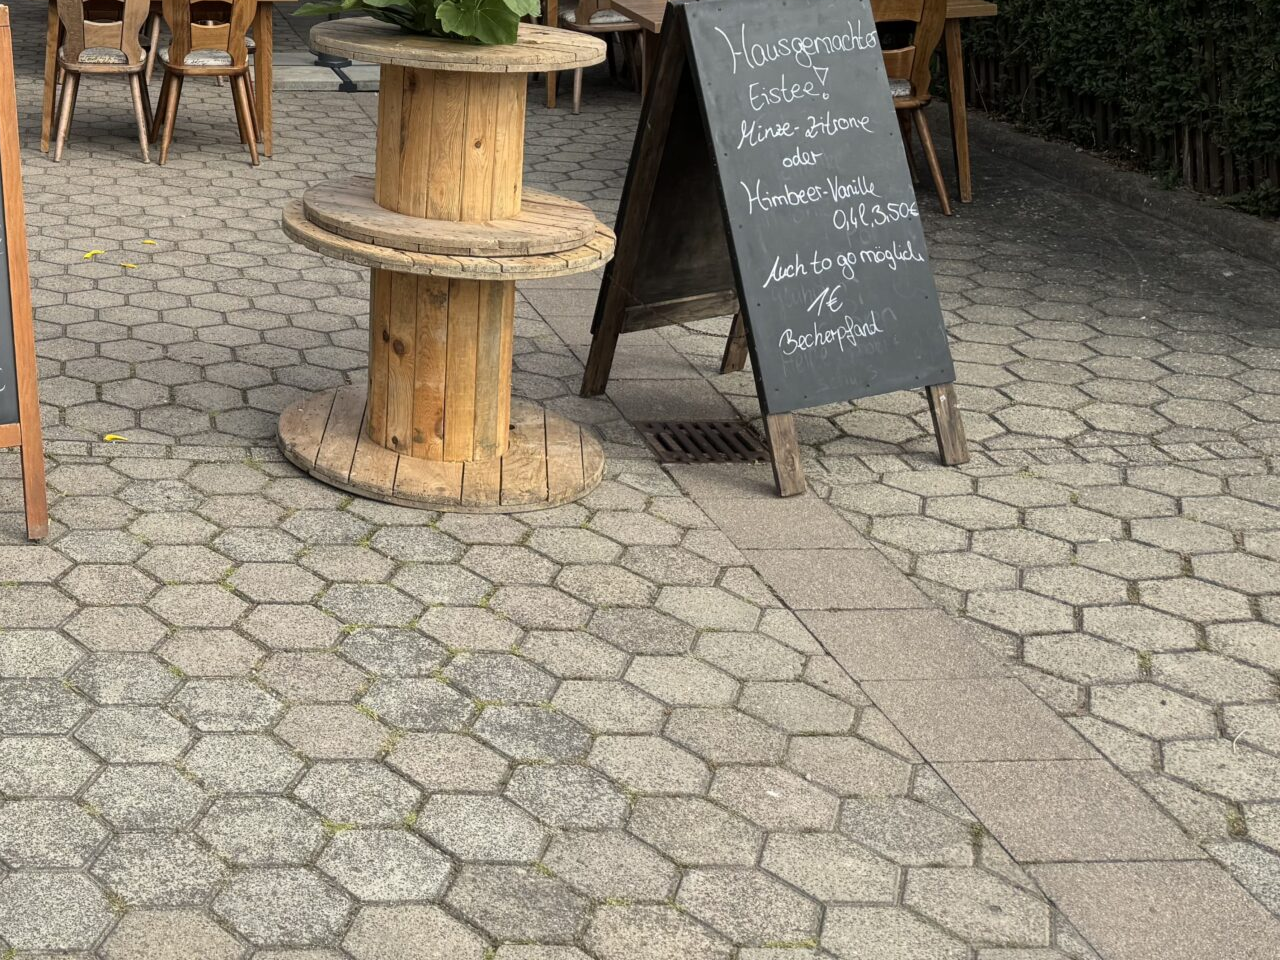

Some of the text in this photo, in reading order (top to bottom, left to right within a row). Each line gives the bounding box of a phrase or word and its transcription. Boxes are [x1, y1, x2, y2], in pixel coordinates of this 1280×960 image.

[782, 146, 824, 168] oder
[762, 241, 925, 289] Auch to go möglich
[806, 284, 844, 317] 1€
[778, 310, 884, 356] Becherpfand
